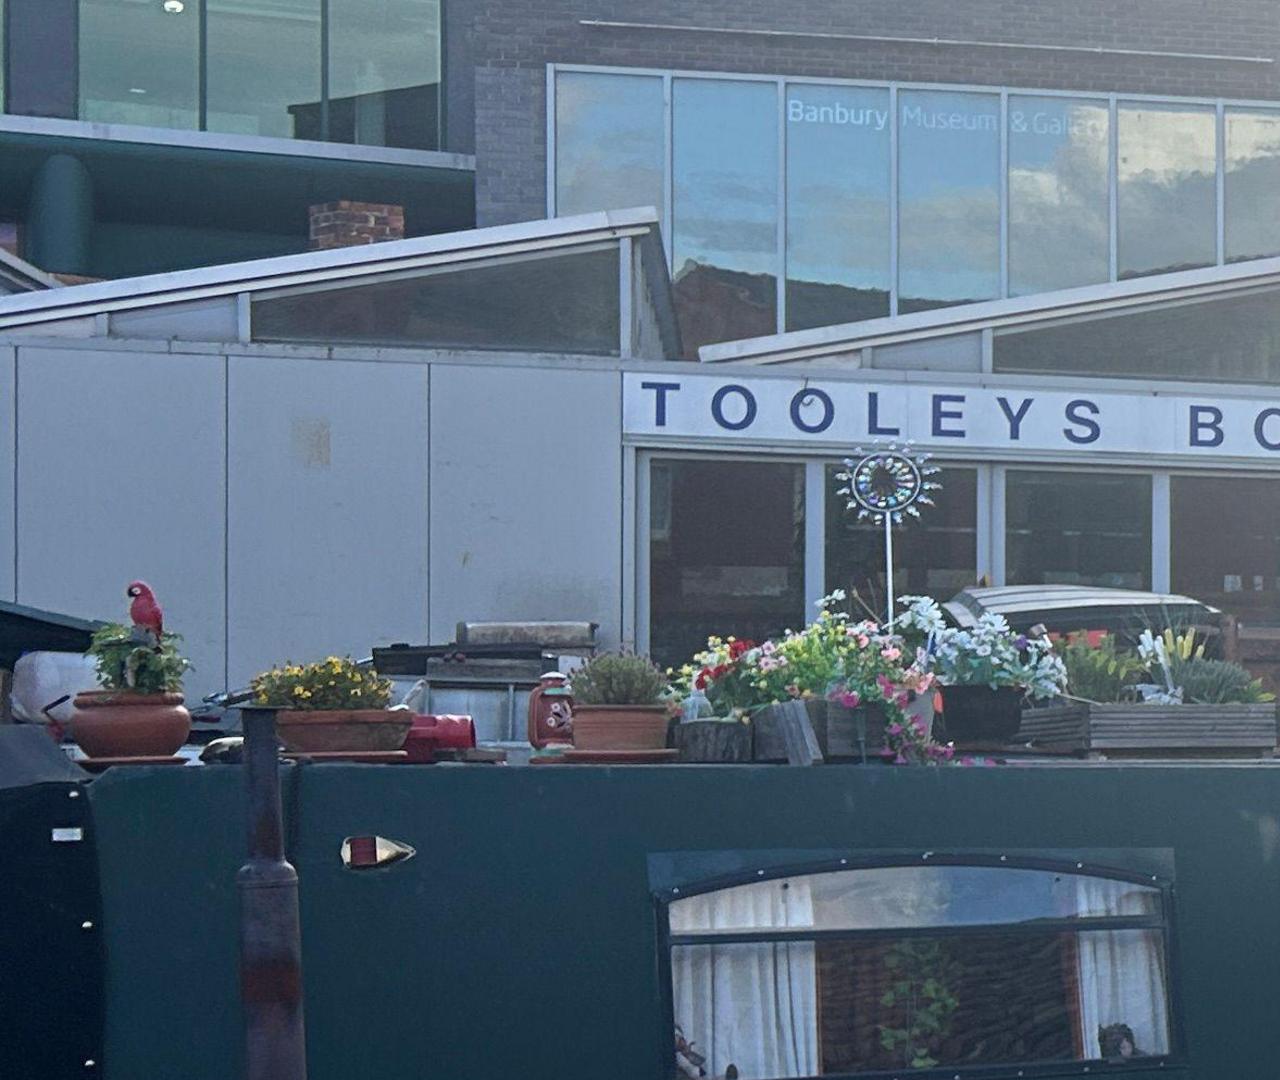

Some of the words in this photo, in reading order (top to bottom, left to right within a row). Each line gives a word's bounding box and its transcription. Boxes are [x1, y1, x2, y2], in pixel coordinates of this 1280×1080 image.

[788, 100, 888, 131] Banbury
[902, 106, 997, 130] Museum
[1009, 111, 1028, 133] &
[641, 382, 1100, 444] TOOLEYS
